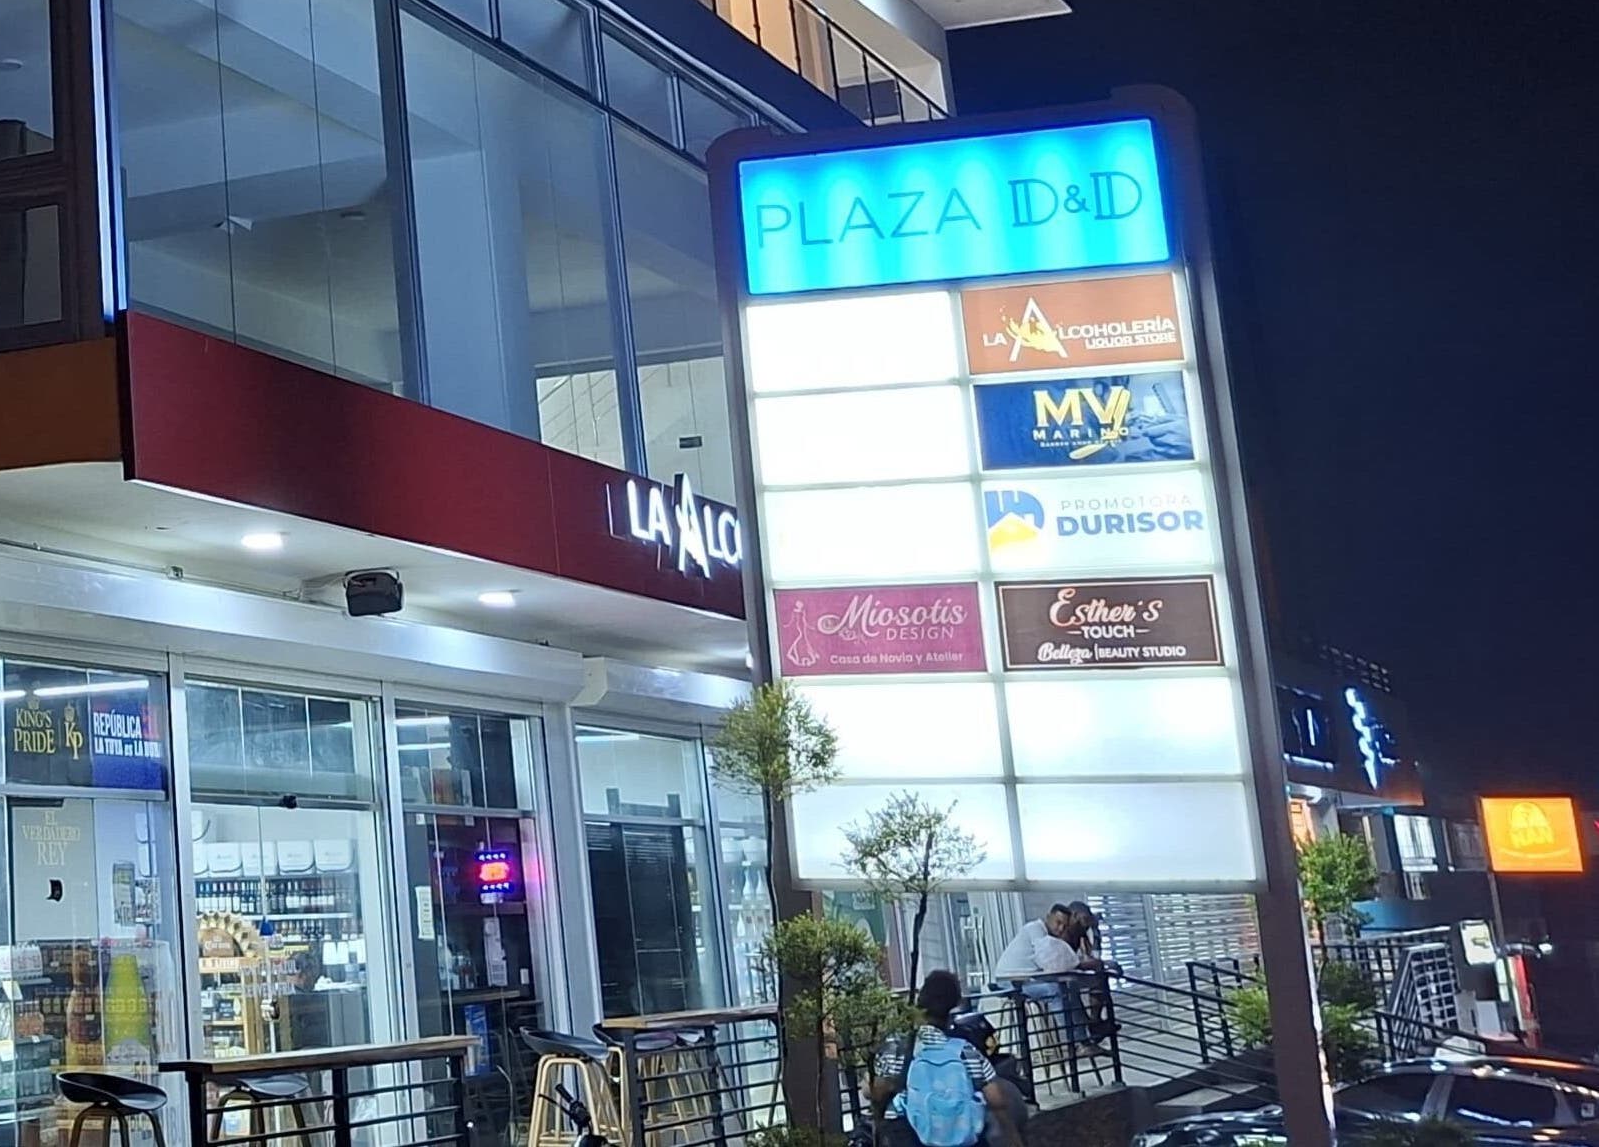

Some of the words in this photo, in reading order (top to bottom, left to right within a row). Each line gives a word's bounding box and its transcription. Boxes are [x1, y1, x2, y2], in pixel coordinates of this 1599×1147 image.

[755, 187, 982, 248] PLAZA
[1007, 170, 1143, 228] D&D
[982, 332, 1008, 348] LA
[1084, 336, 1132, 350] LIQUOR
[1131, 331, 1177, 346] STORE
[626, 478, 673, 547] LA
[1060, 495, 1193, 512] PROMOTORA
[1056, 509, 1205, 537] DURISOR
[816, 593, 968, 637] Miosotis
[885, 626, 956, 641] DESIGN
[1080, 625, 1136, 639] TOUCH
[829, 654, 861, 664] Casa
[862, 653, 878, 663] de
[879, 651, 913, 663] Novia
[914, 654, 923, 665] y
[925, 650, 964, 662] Atelier
[1036, 641, 1093, 666] Belleza
[1098, 646, 1142, 658] BEAUTY
[1142, 645, 1187, 658] STUDIO
[15, 708, 52, 728] KING'S
[92, 709, 143, 739] REPÚBLICA
[13, 728, 57, 754] PRIDE
[94, 736, 105, 754] LA
[44, 810, 58, 826] EL
[20, 824, 82, 842] VERDADERO
[36, 841, 69, 867] REY
